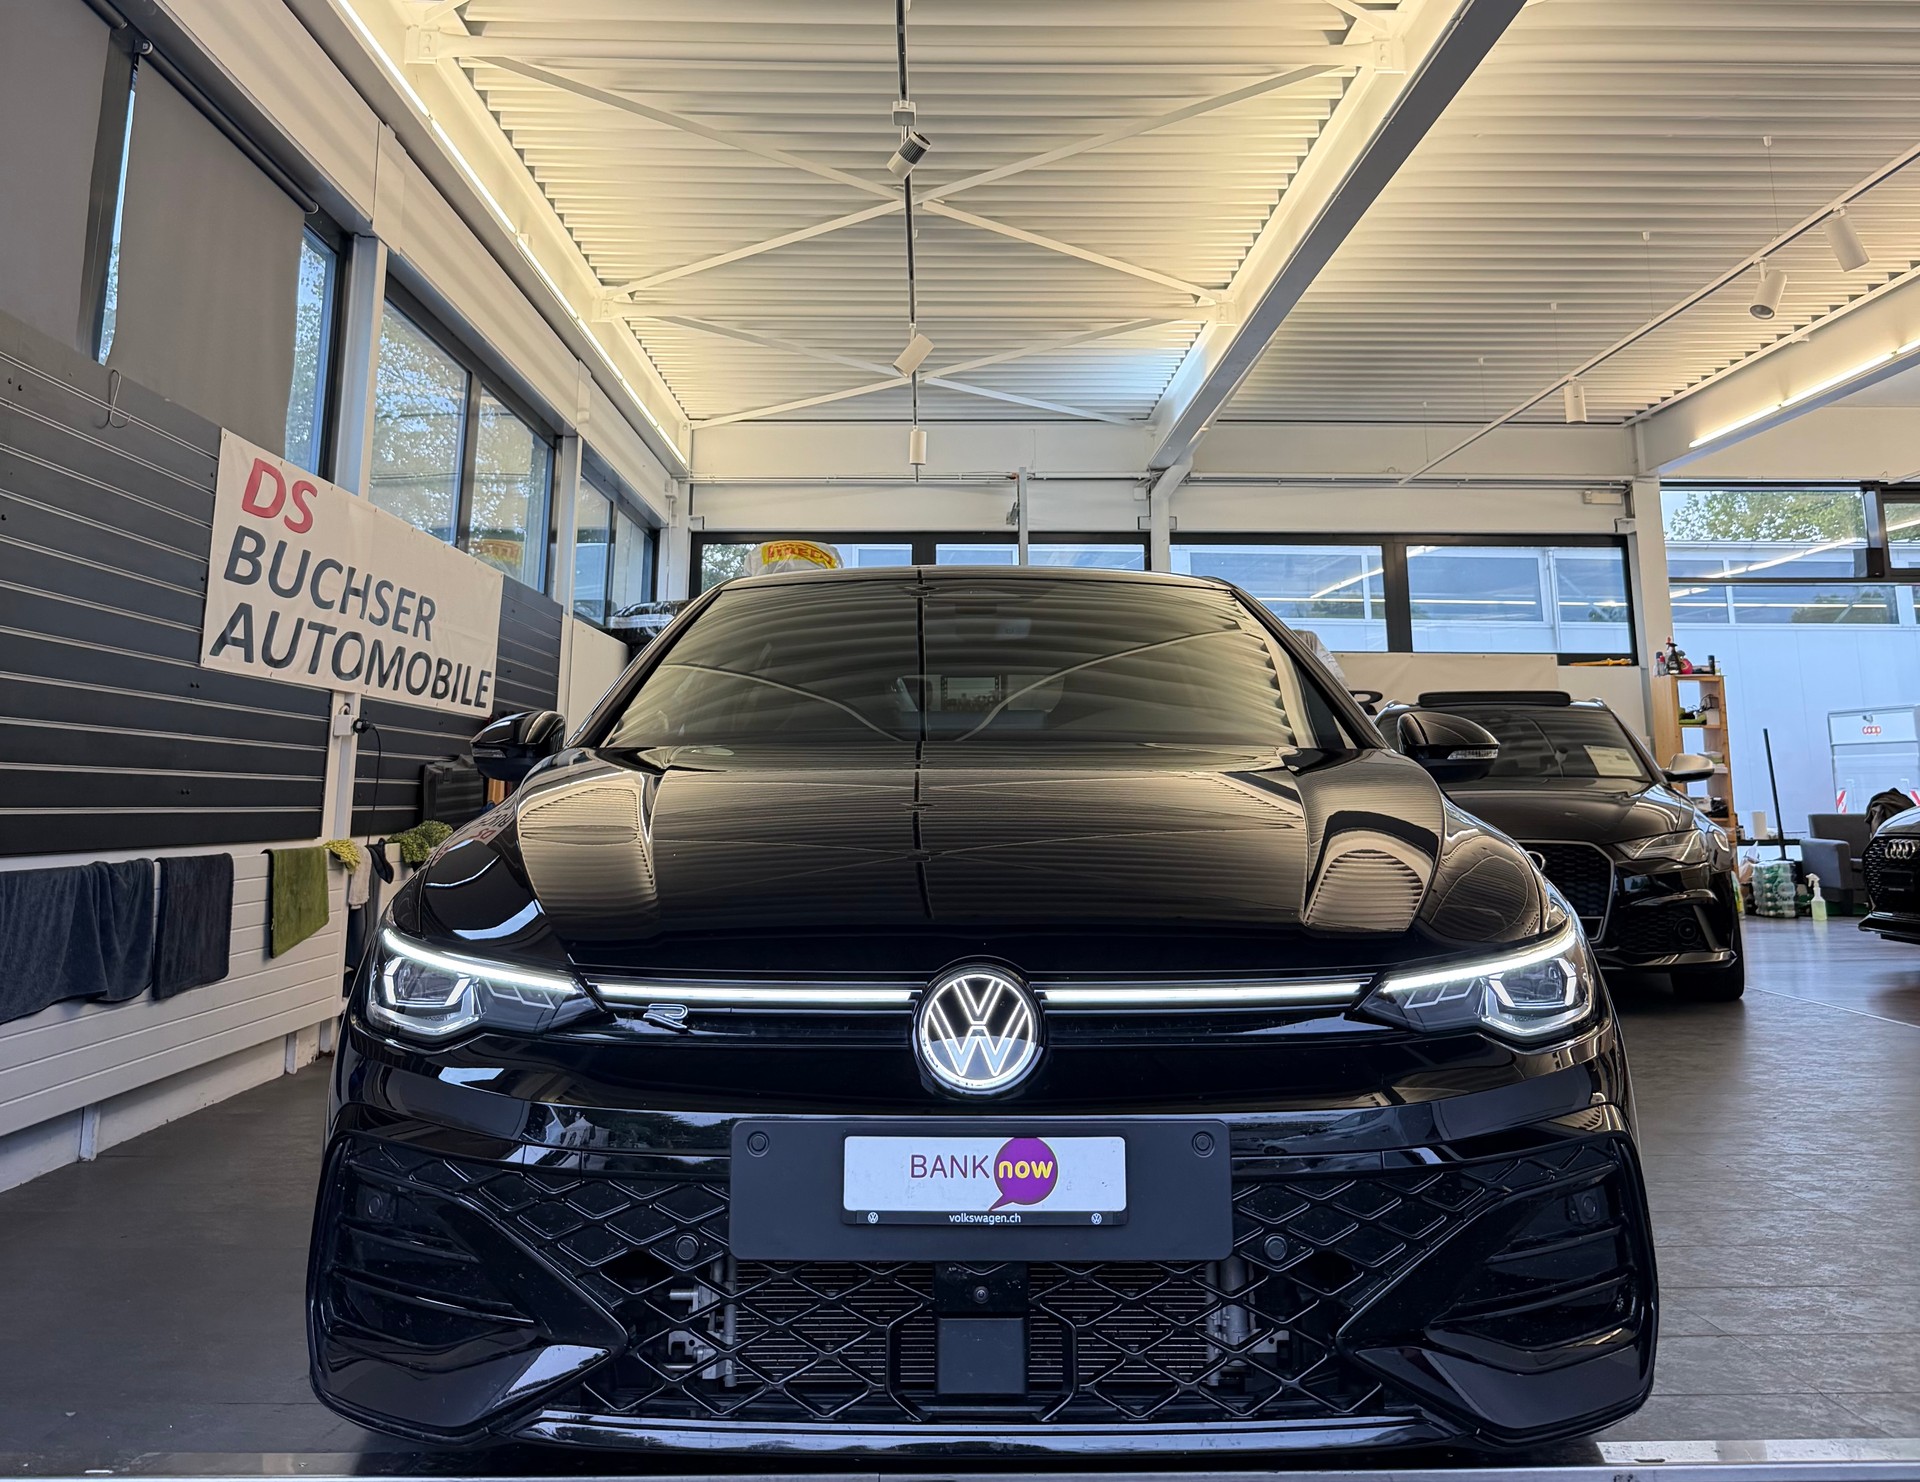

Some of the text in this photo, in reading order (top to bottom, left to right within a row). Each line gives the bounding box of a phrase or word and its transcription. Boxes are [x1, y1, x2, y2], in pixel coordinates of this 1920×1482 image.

[241, 457, 318, 534] DS
[223, 525, 436, 642] BUCHSER
[209, 602, 492, 708] AUTOMOBILE
[910, 1154, 1054, 1179] BANK now
[949, 1212, 1021, 1225] volkswagen.ch
